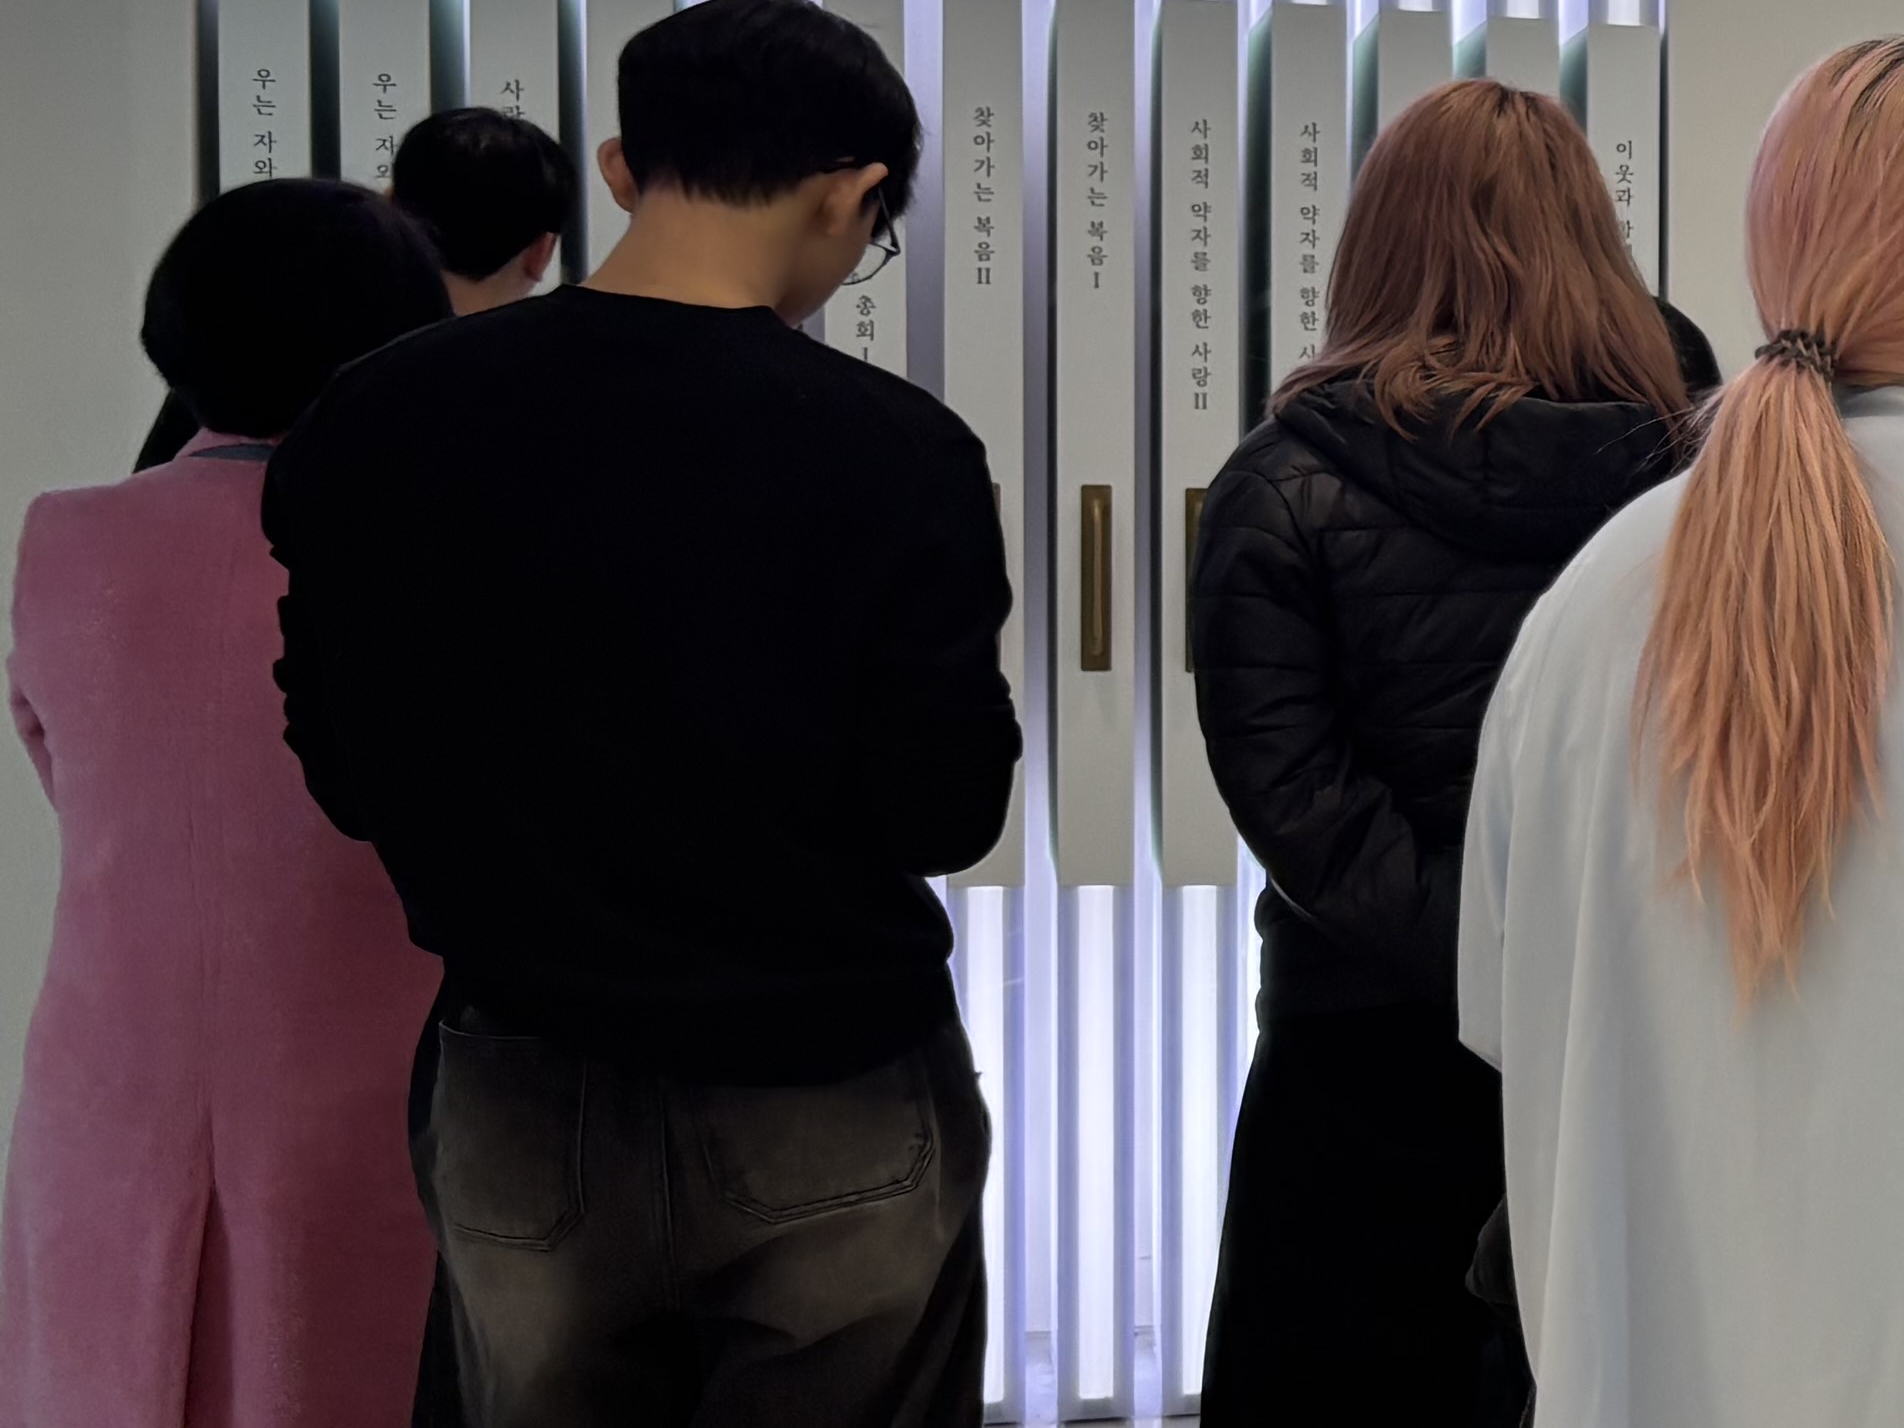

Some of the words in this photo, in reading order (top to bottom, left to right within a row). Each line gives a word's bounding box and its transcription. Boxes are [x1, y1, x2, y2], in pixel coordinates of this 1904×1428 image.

[252, 68, 276, 117] 우는
[372, 73, 397, 121] 우는
[972, 106, 995, 204] 찾아가는
[1086, 111, 1109, 209] 찾아가는
[1190, 118, 1212, 190] 사회적
[1299, 122, 1320, 193] 사회적
[1615, 140, 1635, 208] 이웃과
[1190, 201, 1212, 273] 약자를
[1299, 204, 1320, 275] 약자를
[1190, 283, 1212, 331] 향한
[1299, 285, 1320, 333] 향한
